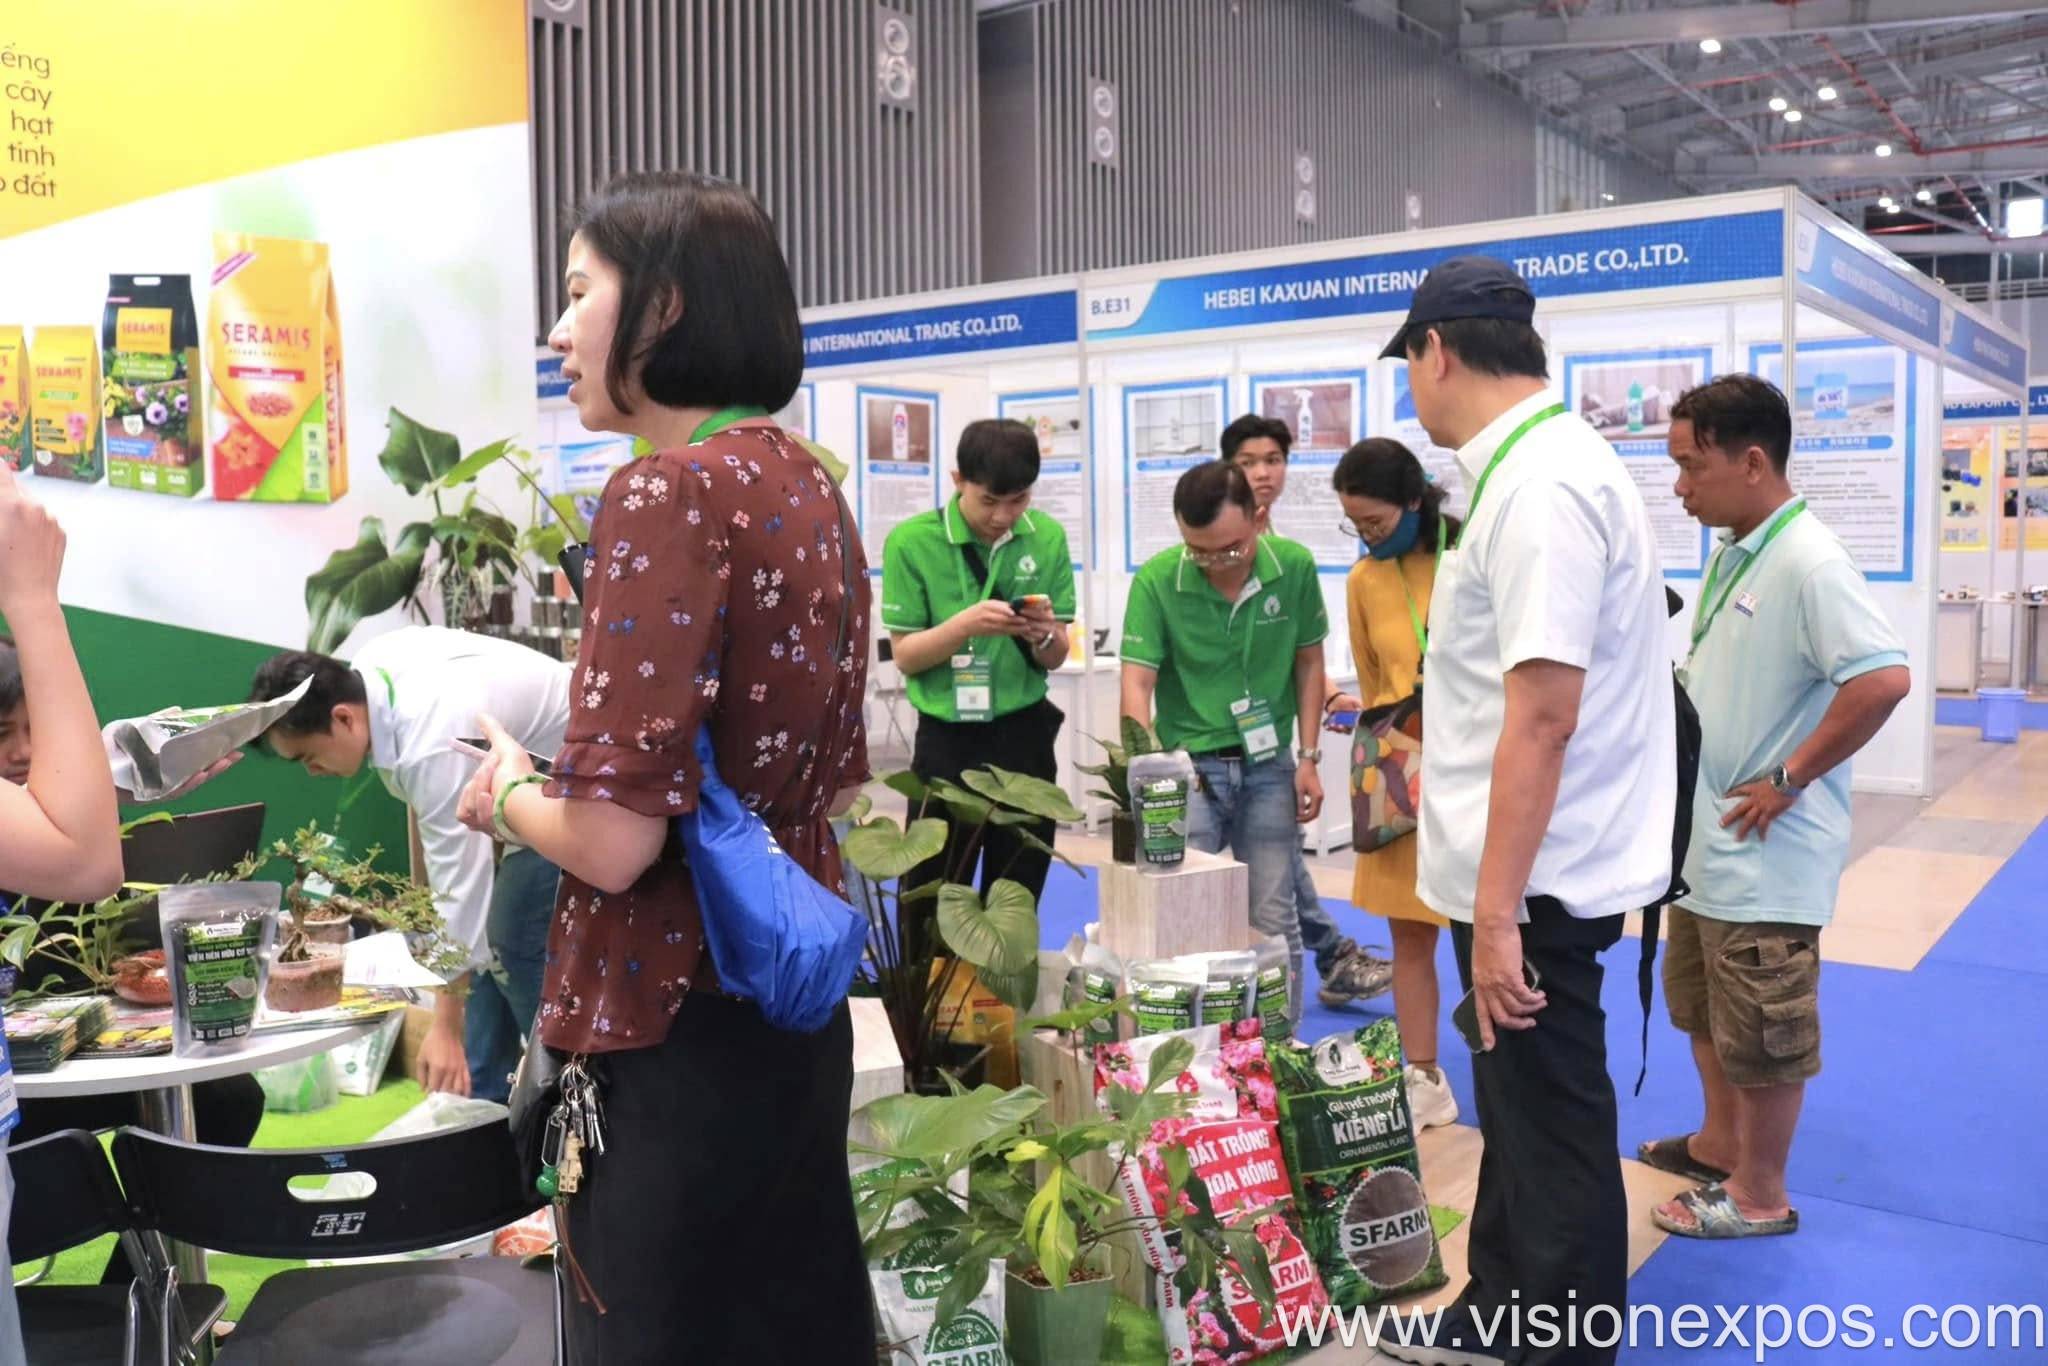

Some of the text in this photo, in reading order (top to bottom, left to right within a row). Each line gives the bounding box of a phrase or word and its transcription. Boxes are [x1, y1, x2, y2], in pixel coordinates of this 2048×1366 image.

[11, 109, 54, 140] hạt
[1514, 243, 1690, 278] TRADE CO.,LTD.
[1204, 269, 1430, 310] HEBEI KAXUAN INTERNA
[1091, 298, 1131, 315] B.E31
[222, 321, 311, 351] SERAMIS
[810, 314, 1023, 354] INTERNATIONAL TRADE CO.,LTD.
[1218, 1127, 1271, 1158] TRỒNG
[1236, 1156, 1279, 1186] HỒNG
[1350, 1209, 1427, 1247] SFARM
[1163, 1277, 1175, 1308] ARM
[1231, 1259, 1309, 1299] SRM
